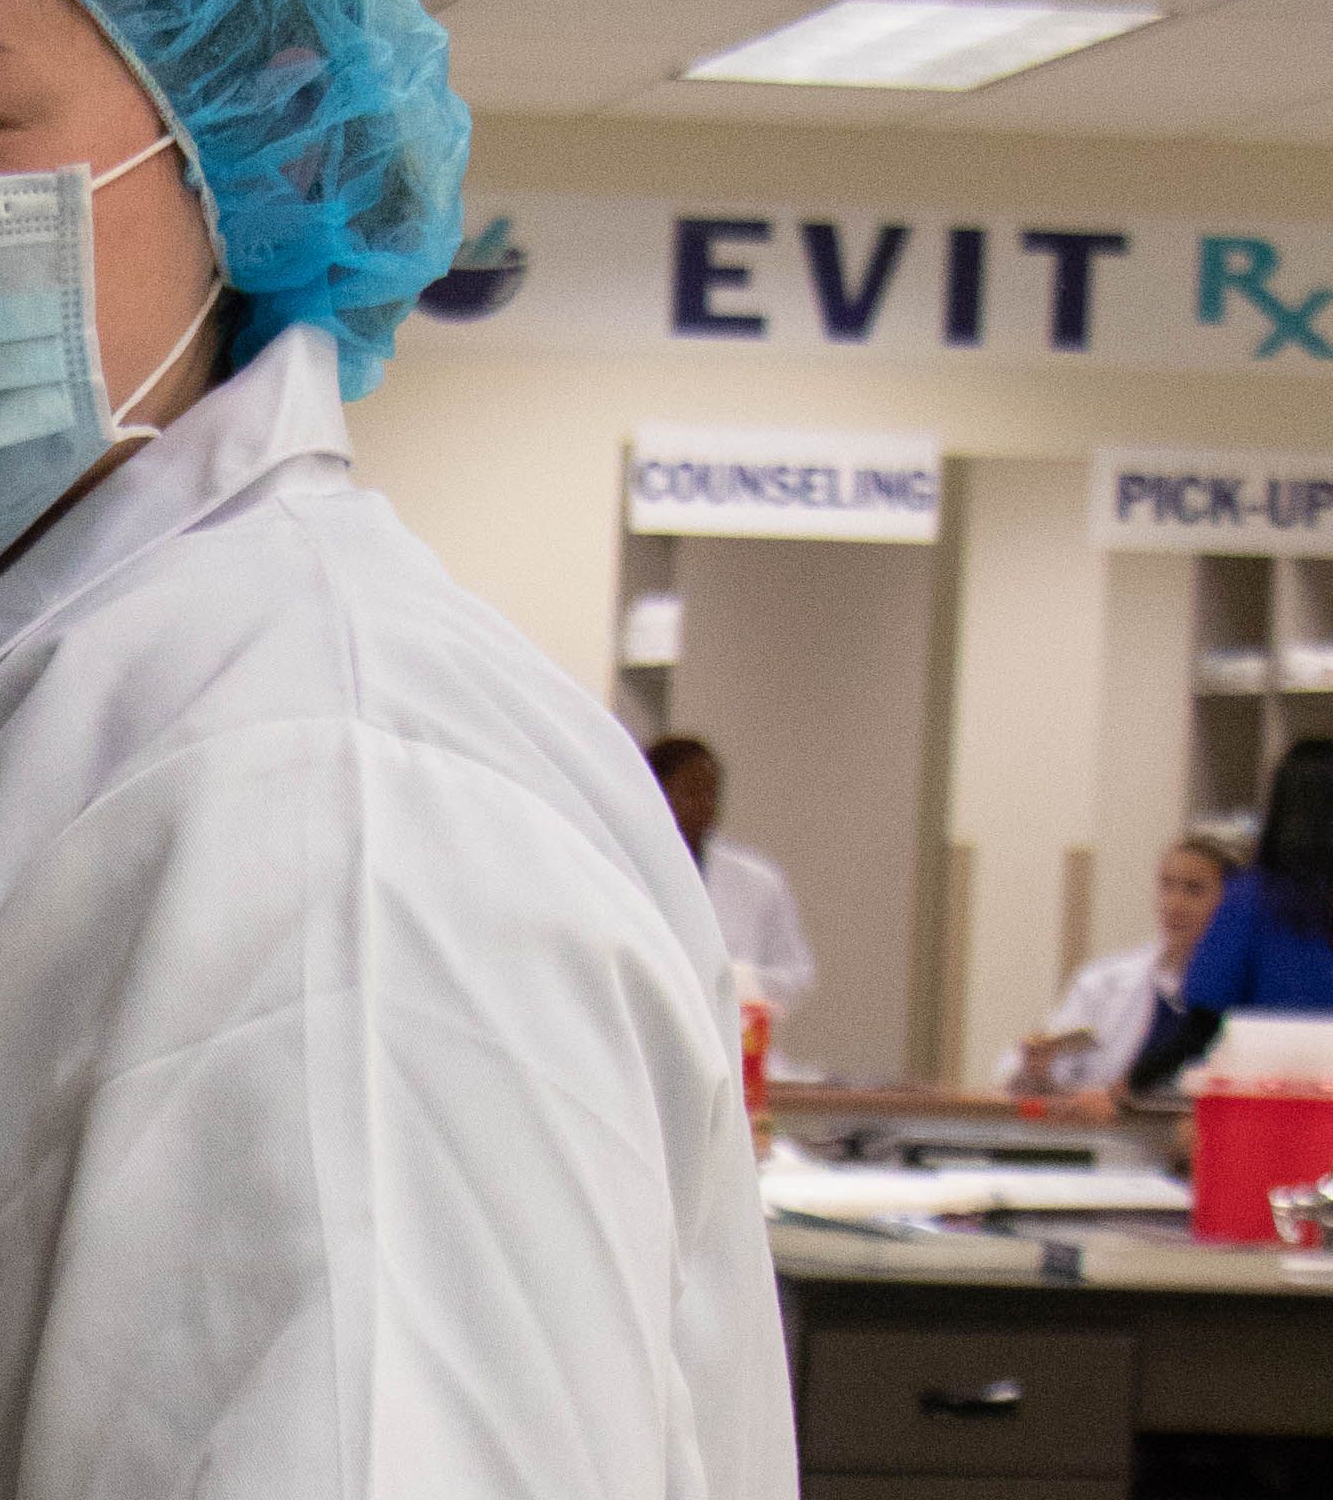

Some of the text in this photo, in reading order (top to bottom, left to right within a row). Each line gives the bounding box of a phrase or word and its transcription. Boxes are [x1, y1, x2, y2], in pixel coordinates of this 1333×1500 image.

[668, 217, 1130, 353] EVIT
[632, 460, 935, 514] COUNSELING
[1117, 473, 1333, 530] PICK-UP
